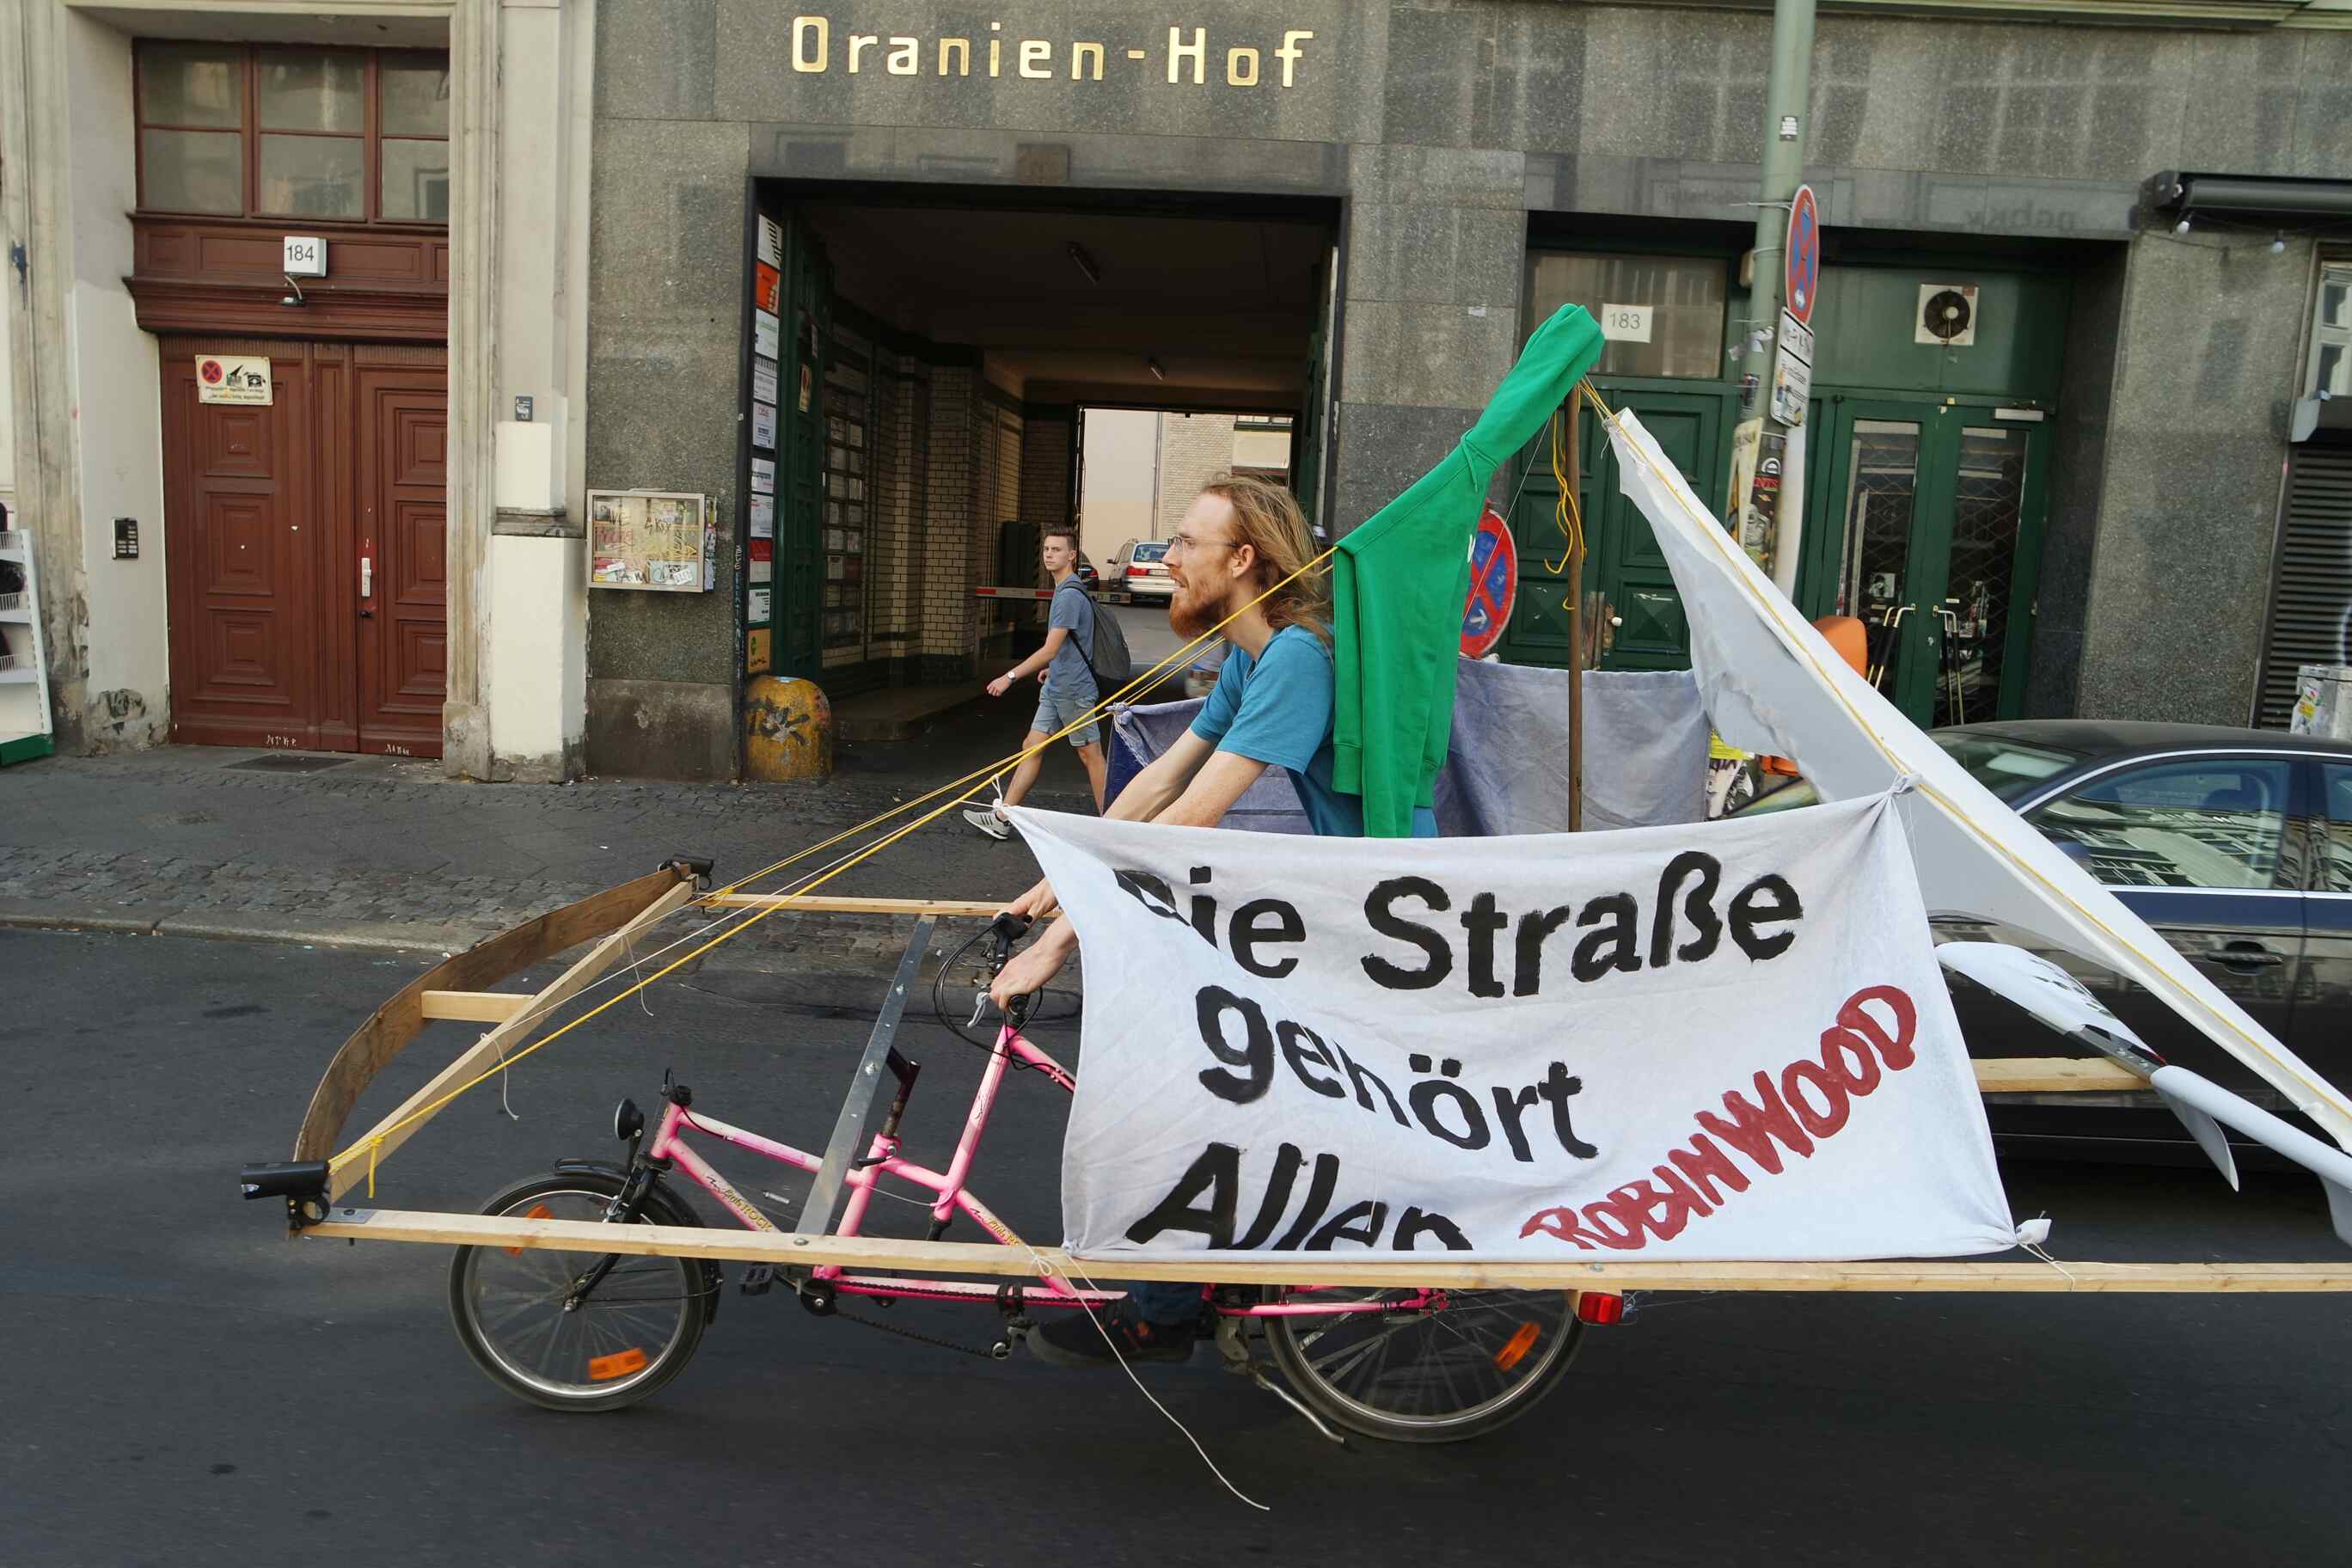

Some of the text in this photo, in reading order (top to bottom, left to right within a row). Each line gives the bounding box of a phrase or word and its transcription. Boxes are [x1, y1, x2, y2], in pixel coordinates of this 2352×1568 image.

[791, 15, 1314, 88] Oranien-Hof
[286, 244, 315, 261] 184
[1609, 312, 1640, 329] 183
[1360, 850, 1804, 998] Straße
[1195, 985, 1599, 1162] gehört
